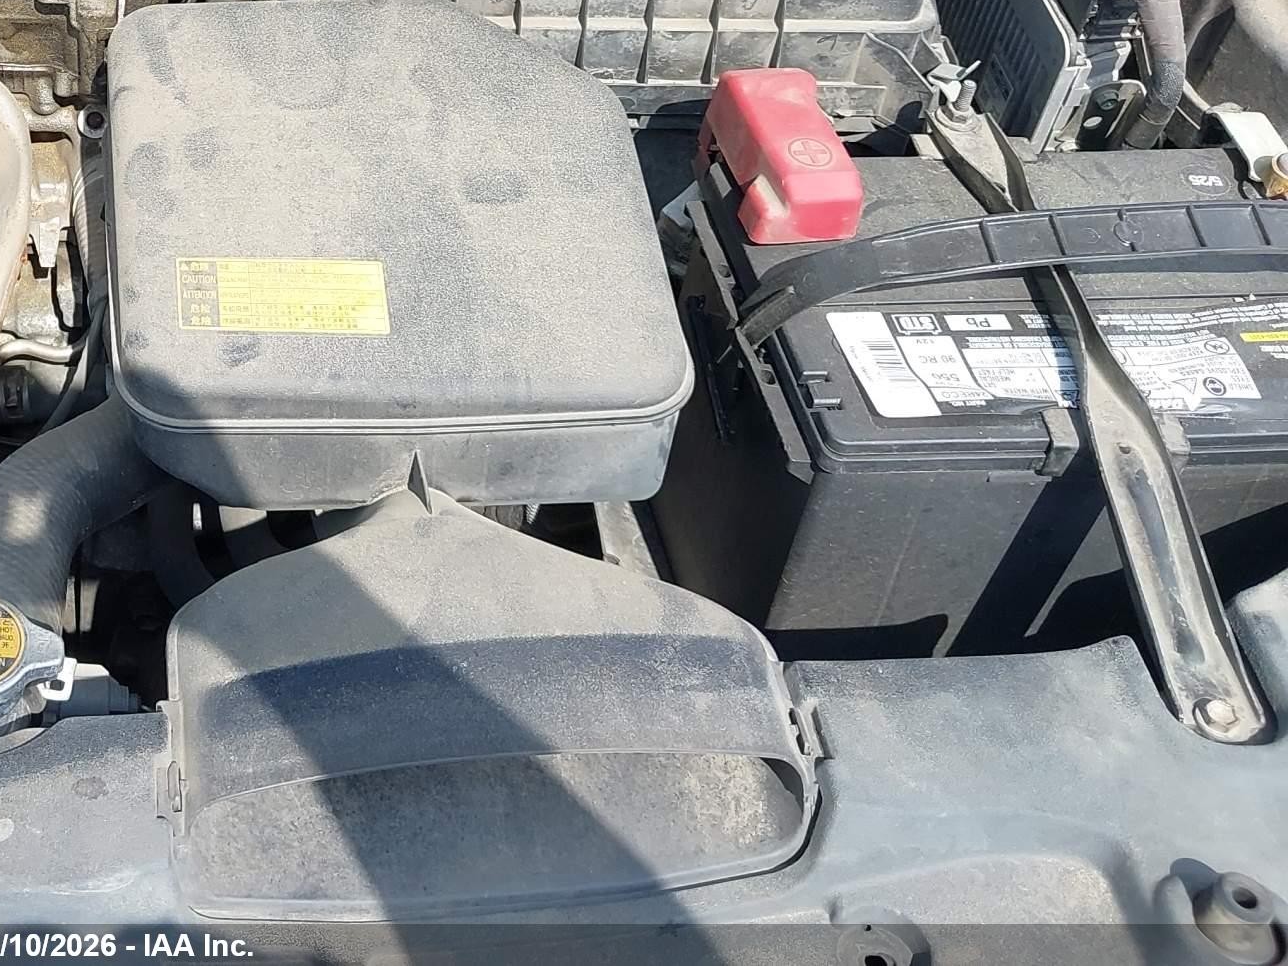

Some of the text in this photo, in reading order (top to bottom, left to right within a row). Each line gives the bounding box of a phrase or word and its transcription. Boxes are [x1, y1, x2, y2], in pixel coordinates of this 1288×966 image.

[1187, 173, 1223, 187] 5/25
[181, 274, 216, 283] CAUTION
[182, 289, 216, 298] ATTENTION
[964, 316, 991, 328] Pb
[917, 354, 956, 364] 90 RC
